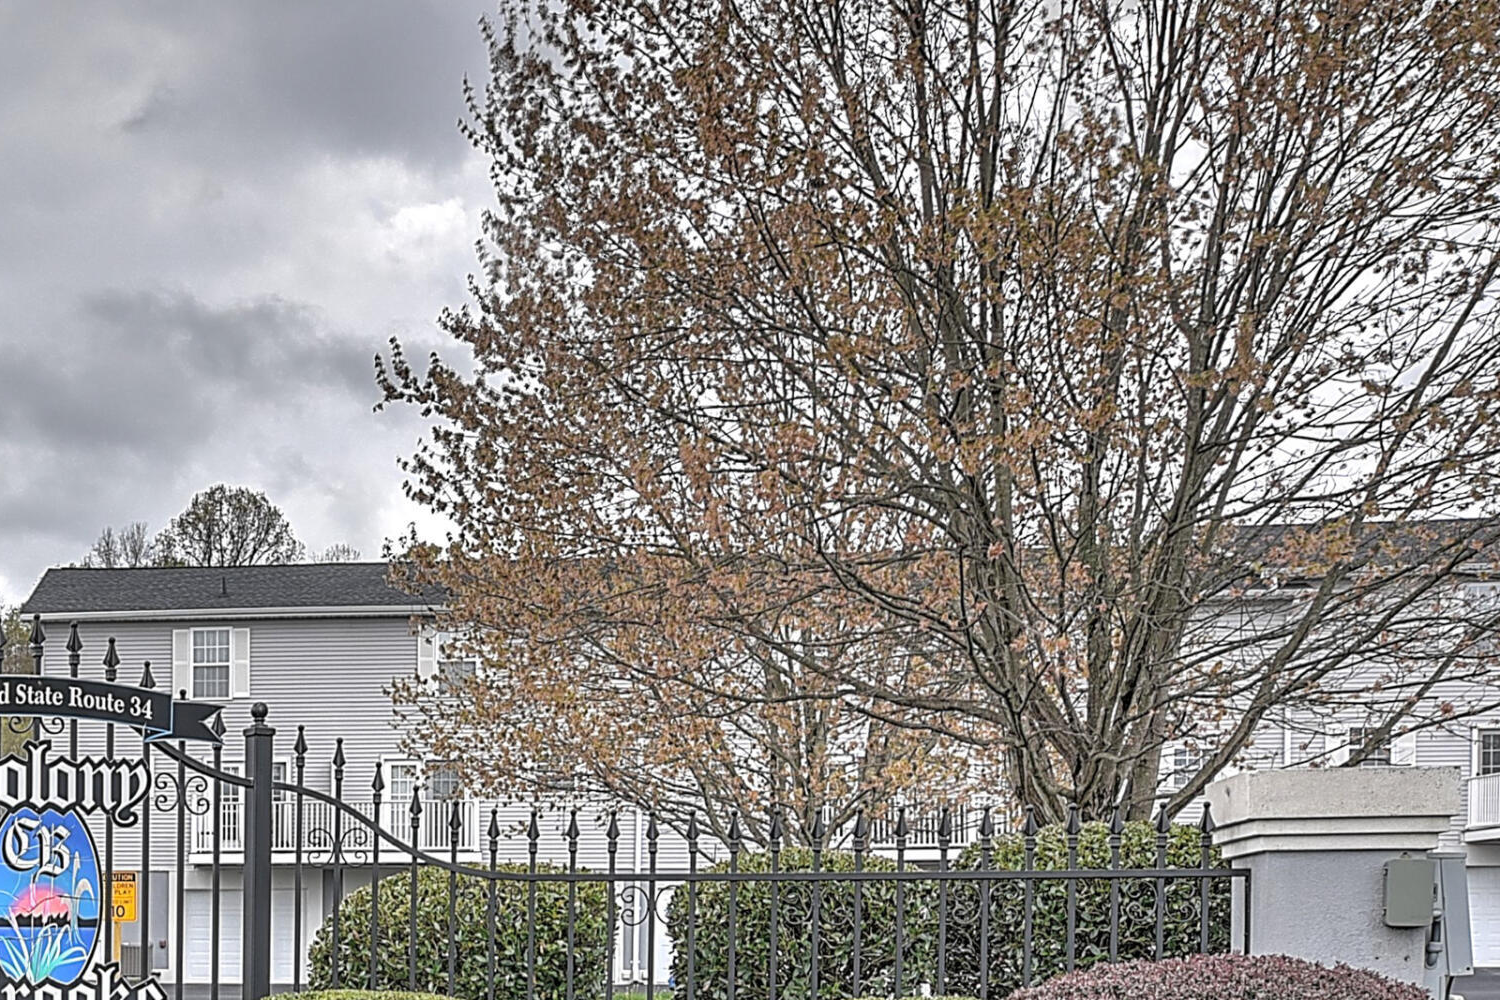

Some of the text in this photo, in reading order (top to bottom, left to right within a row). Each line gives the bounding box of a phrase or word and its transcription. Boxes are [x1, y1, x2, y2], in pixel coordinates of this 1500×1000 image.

[15, 683, 63, 706] State
[68, 686, 125, 713] Route
[129, 695, 153, 719] 34
